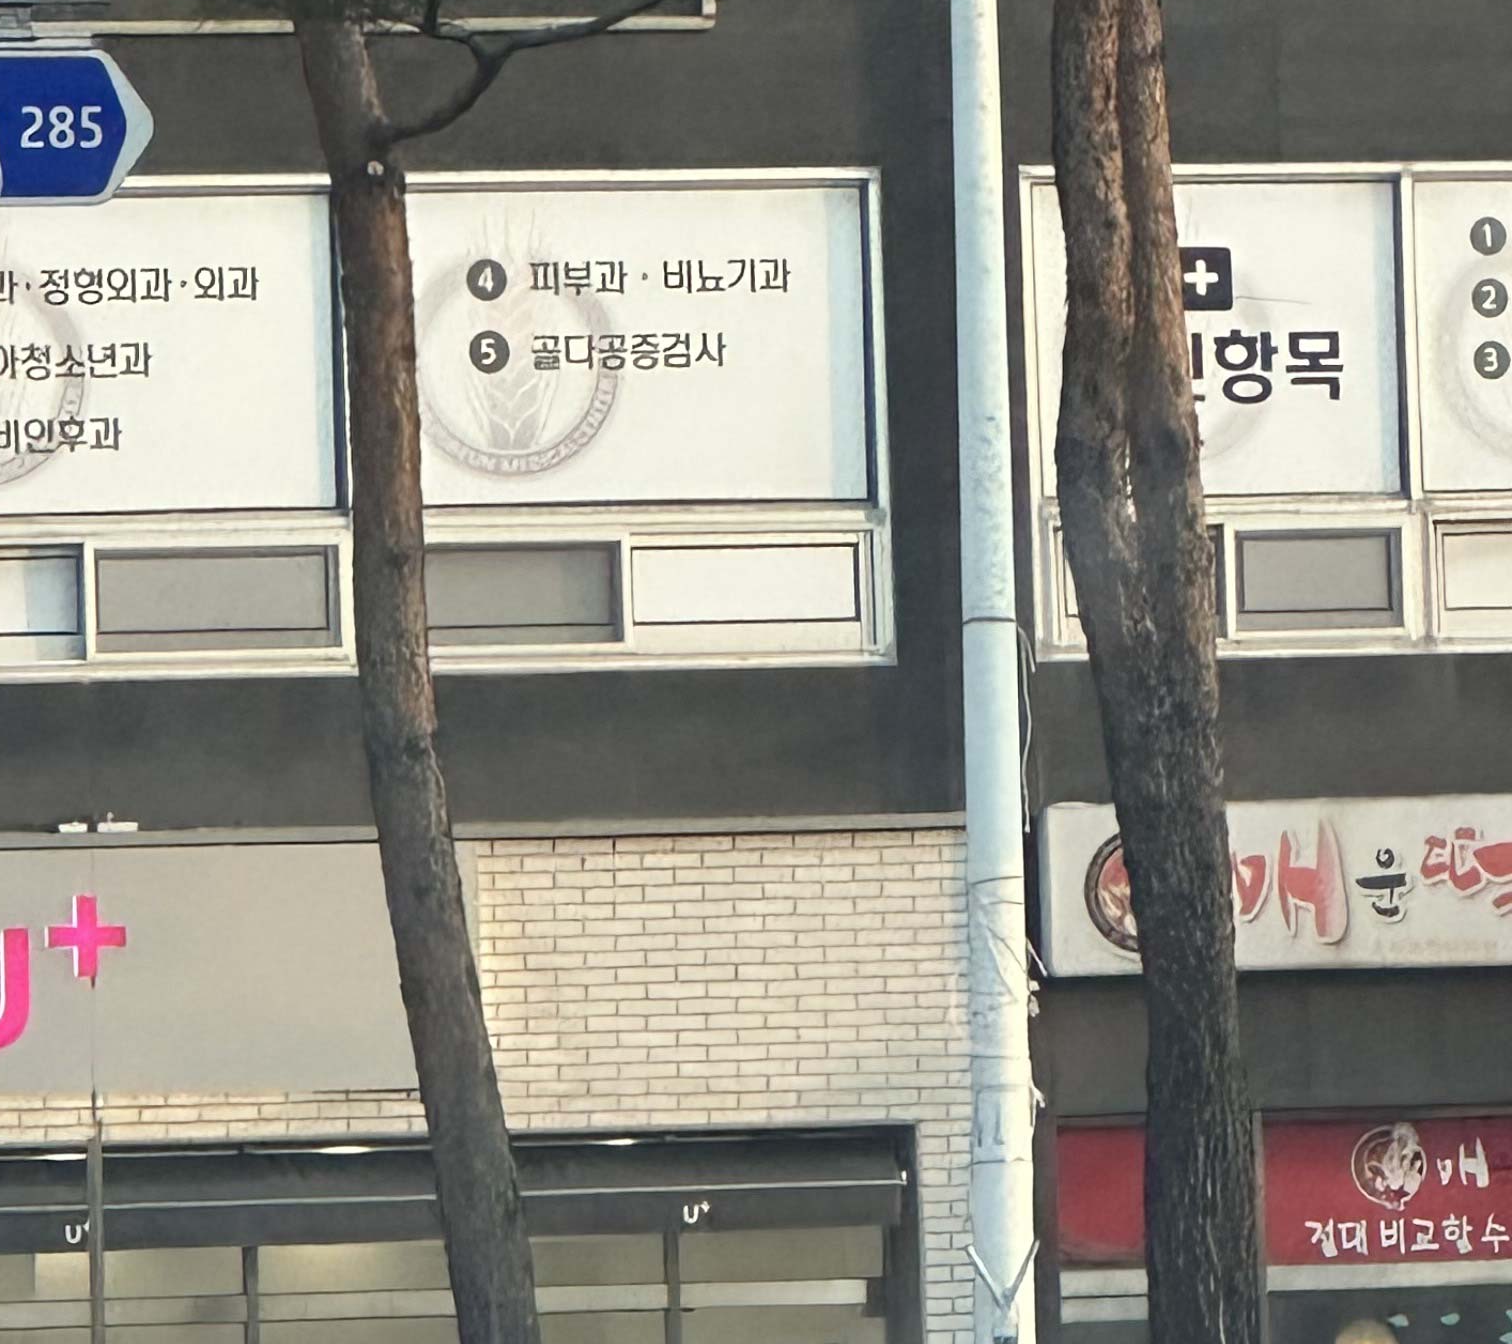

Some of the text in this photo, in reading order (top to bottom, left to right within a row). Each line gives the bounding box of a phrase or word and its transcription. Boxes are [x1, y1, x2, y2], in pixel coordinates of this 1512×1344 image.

[20, 105, 104, 149] 285
[529, 260, 628, 296] 피부과
[663, 258, 791, 294] 비뇨기과
[530, 332, 727, 371] 골다공증검사
[683, 1199, 711, 1225] U+
